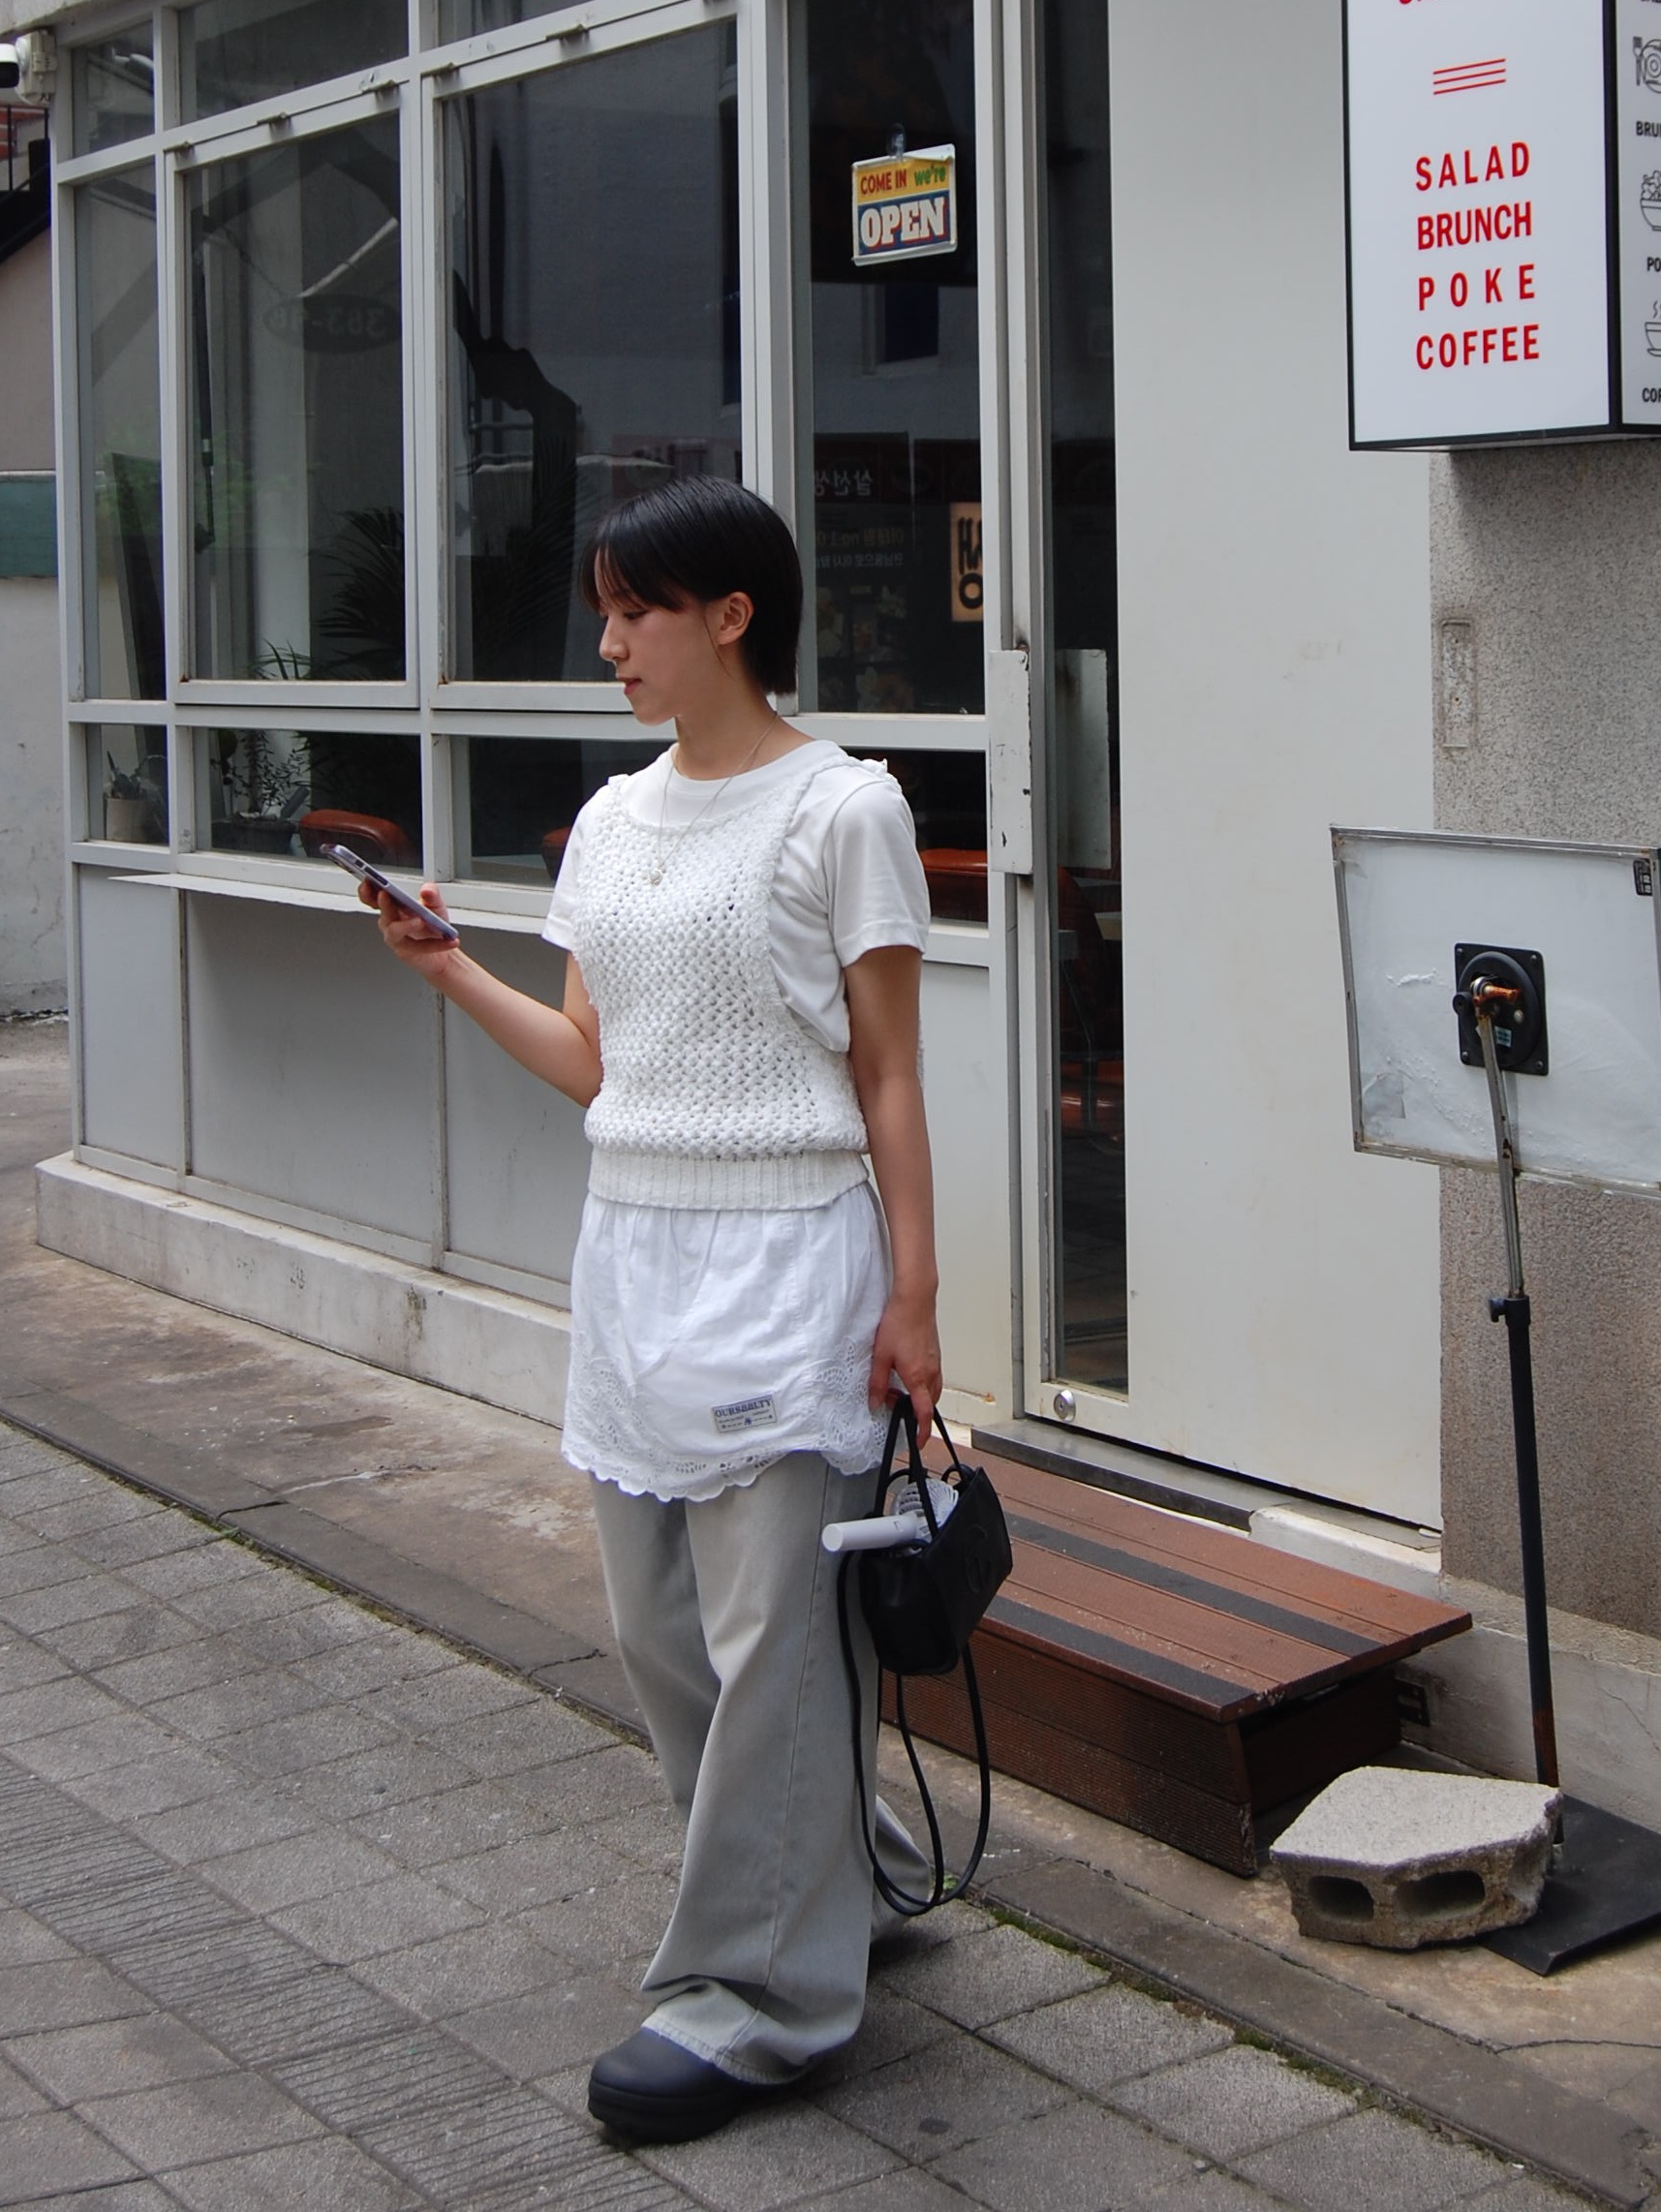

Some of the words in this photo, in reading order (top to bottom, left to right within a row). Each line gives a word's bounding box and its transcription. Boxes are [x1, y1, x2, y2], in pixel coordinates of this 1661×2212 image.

[1636, 120, 1661, 138] BRU
[860, 171, 892, 195] COME
[895, 169, 907, 189] IN
[913, 164, 946, 186] we're
[1415, 140, 1530, 192] SALAD
[860, 197, 945, 250] OPEN
[1417, 200, 1532, 251] BRUNCH
[1417, 262, 1536, 312] POKE
[1415, 323, 1540, 370] COFFEE
